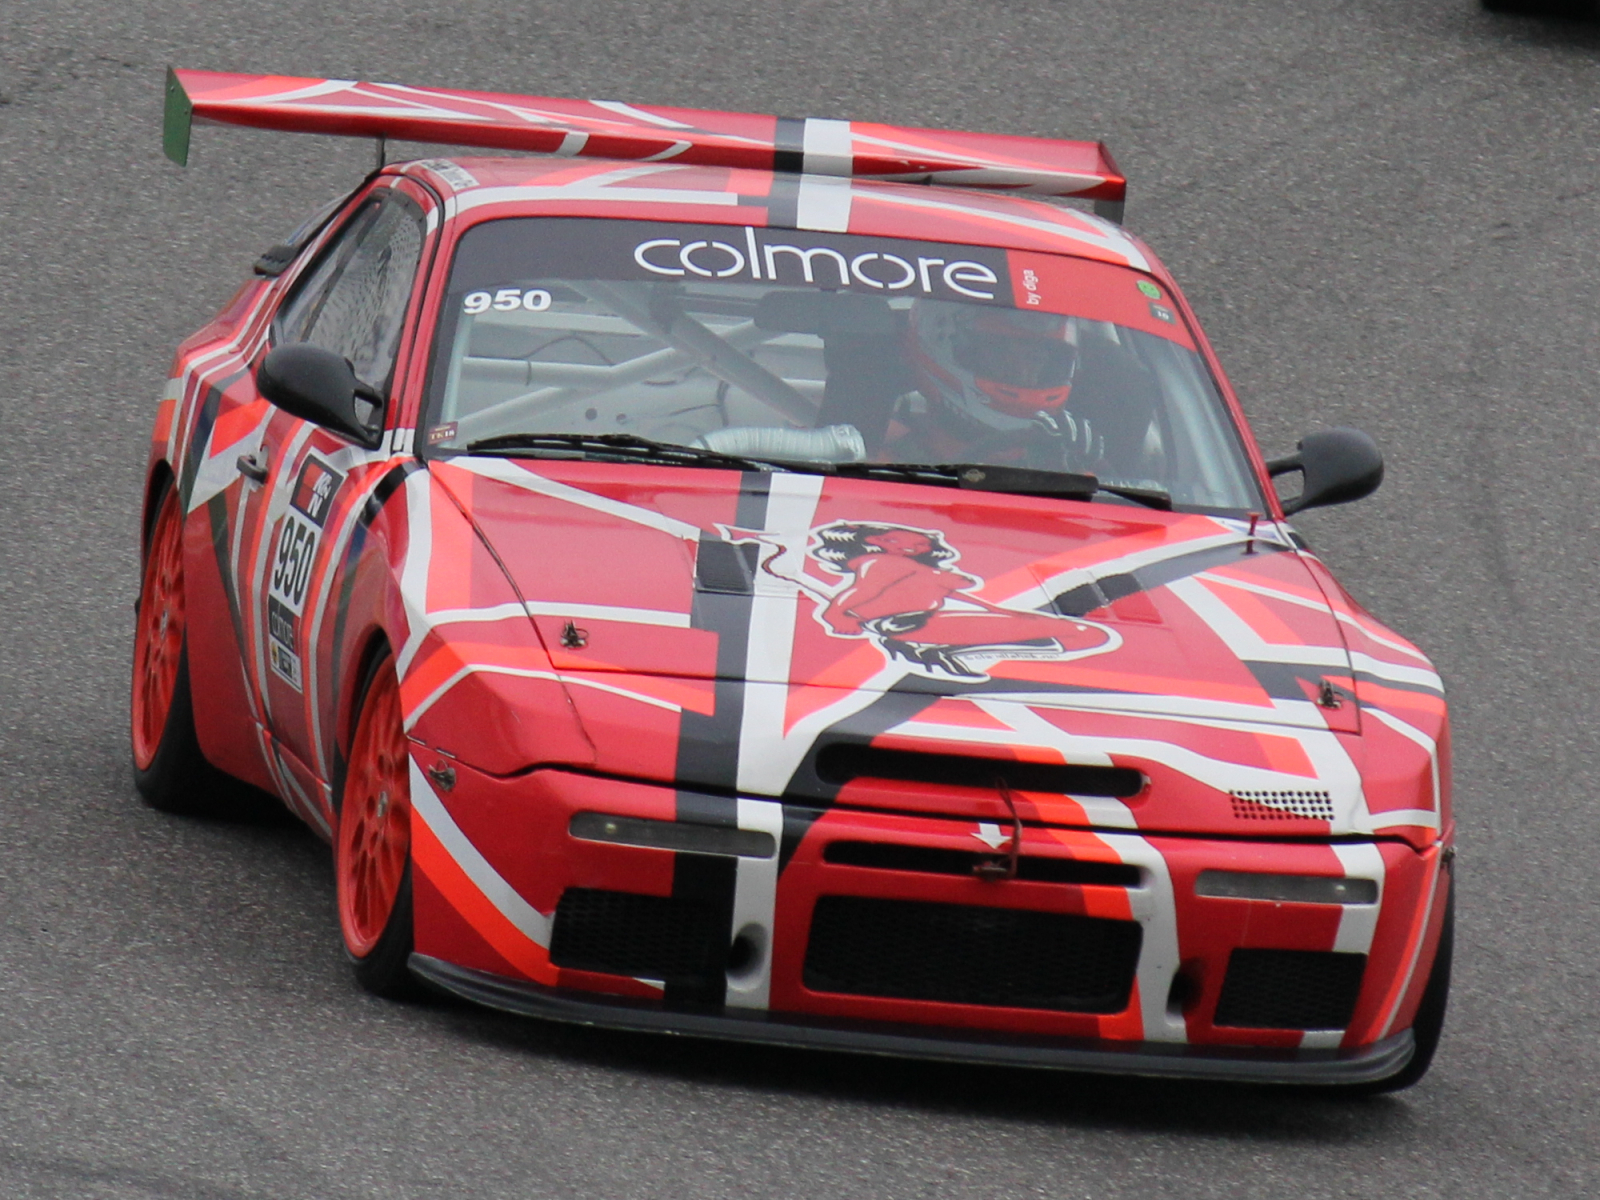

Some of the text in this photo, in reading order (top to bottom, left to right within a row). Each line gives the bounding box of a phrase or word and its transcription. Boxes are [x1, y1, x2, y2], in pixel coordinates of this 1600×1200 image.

[633, 226, 998, 299] colmore
[1022, 269, 1041, 305] by diga
[463, 288, 552, 314] 950
[274, 515, 315, 606] 950
